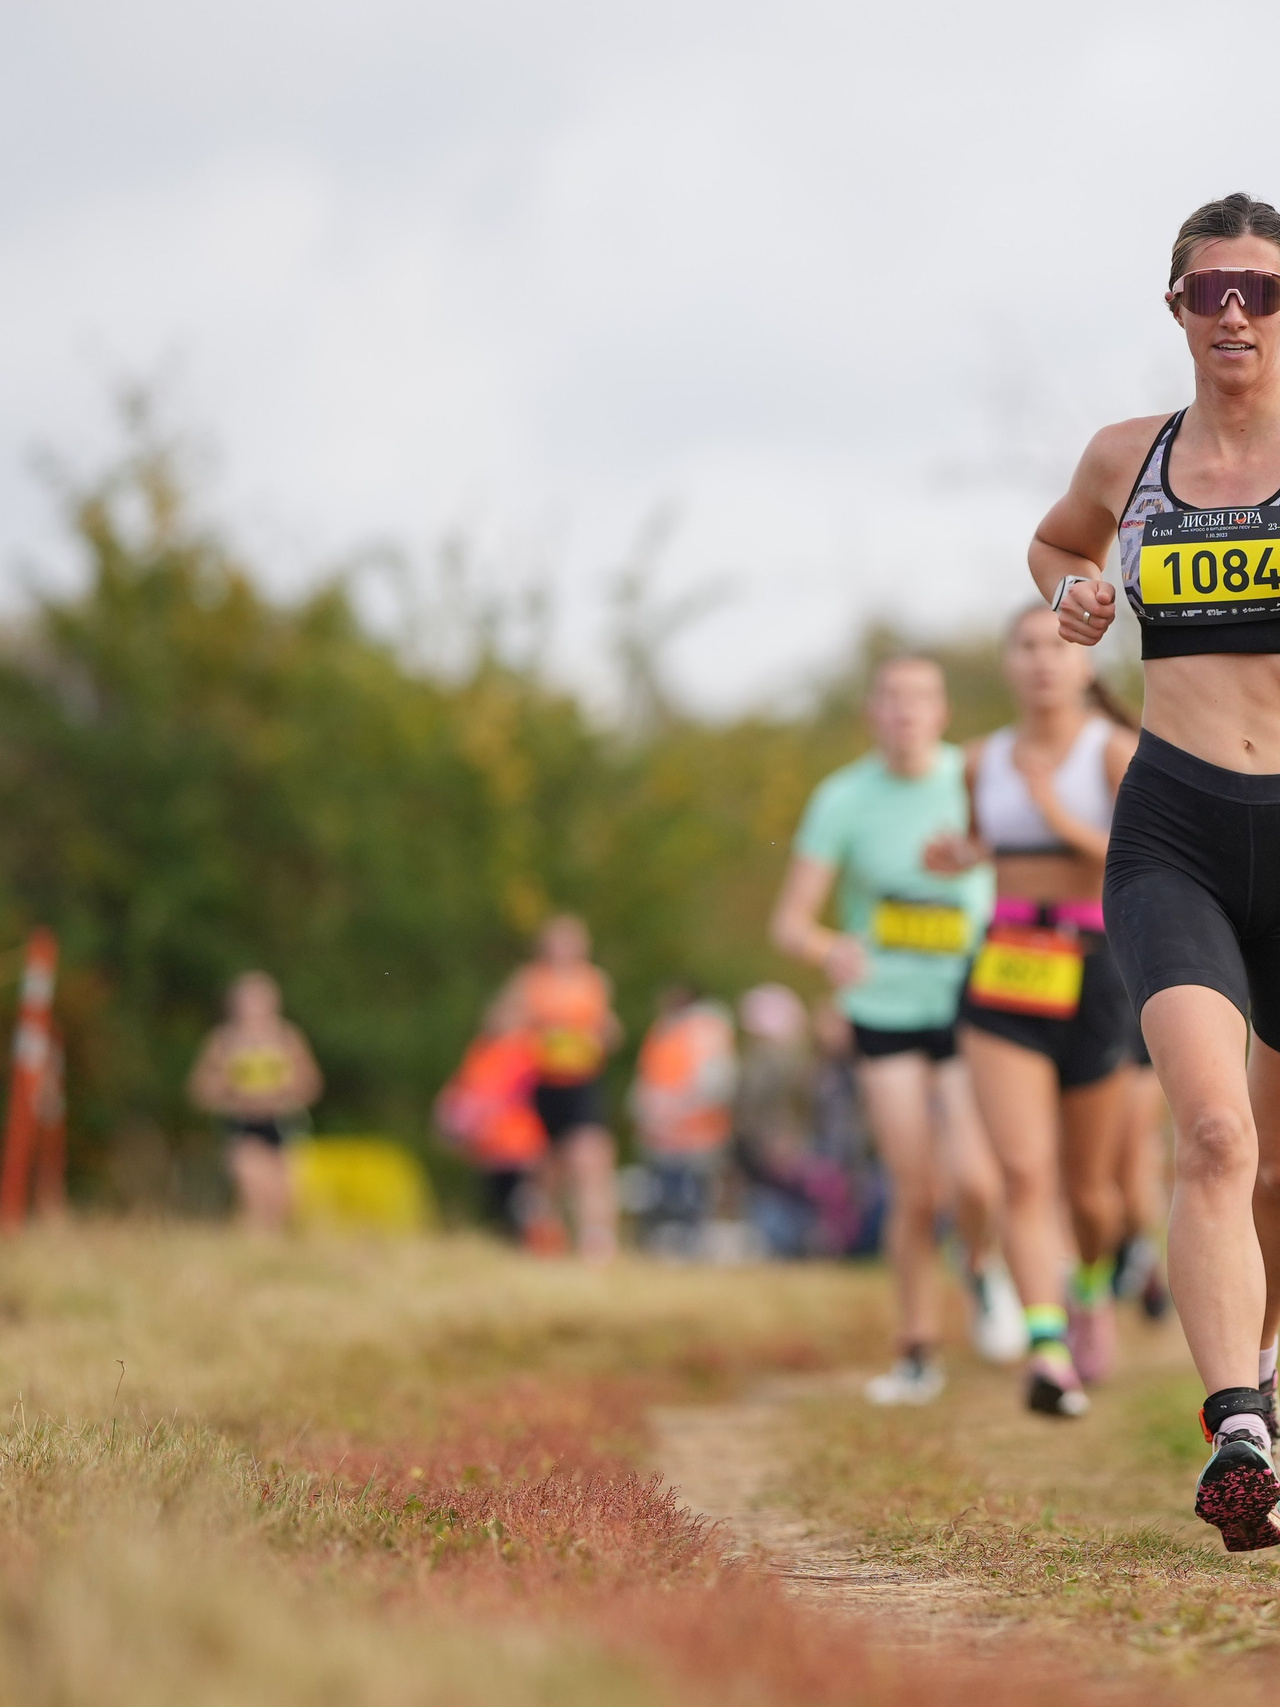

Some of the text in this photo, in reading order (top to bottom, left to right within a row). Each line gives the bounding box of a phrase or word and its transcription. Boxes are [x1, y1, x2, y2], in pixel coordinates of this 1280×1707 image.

[1178, 511, 1263, 529] ЛИСЬЯ ГОРА
[1151, 526, 1159, 538] 6
